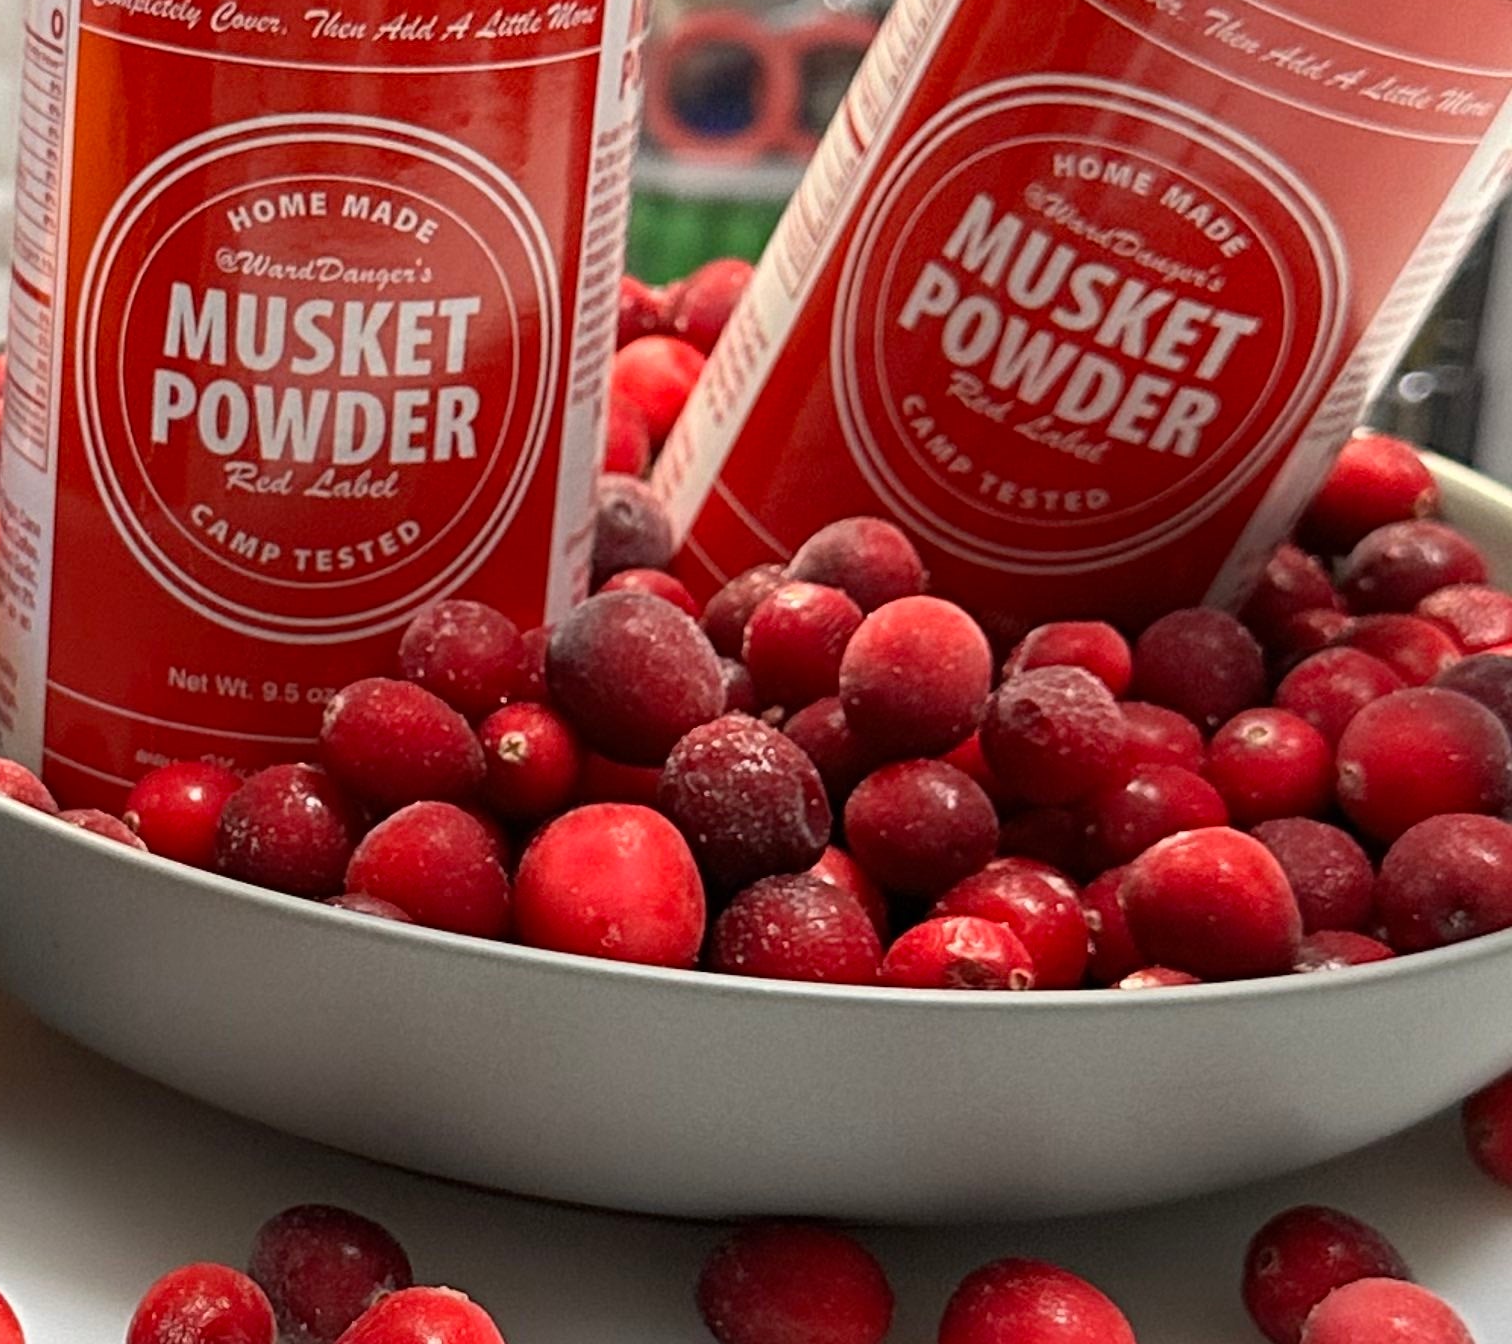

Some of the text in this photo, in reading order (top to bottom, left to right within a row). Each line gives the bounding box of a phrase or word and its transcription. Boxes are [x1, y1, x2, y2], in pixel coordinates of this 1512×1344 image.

[209, 0, 288, 36] Cover.
[303, 8, 366, 39] Then
[371, 11, 439, 41] Add
[439, 11, 474, 41] A
[475, 7, 541, 40] Little
[546, 1, 598, 31] More
[1203, 7, 1261, 54] Then
[1257, 45, 1335, 81] Add
[1322, 66, 1370, 91] A
[1358, 76, 1434, 111] Little
[1435, 86, 1496, 117] More
[226, 191, 439, 244] HOME MADE
[1052, 153, 1252, 259] HOME MADE
[214, 245, 433, 291] @WardDanger's
[940, 190, 1263, 381] MUSKET
[162, 281, 481, 377] MUSKET
[896, 259, 1222, 458] POWDER
[150, 367, 481, 466] POWDER
[901, 393, 1111, 513] CAMP TESTED
[944, 369, 1113, 464] Red Label
[223, 460, 400, 499] Red Label
[190, 503, 421, 572] CAMP TESTED
[167, 665, 209, 694] Net
[215, 674, 254, 701] Wt.
[261, 681, 300, 704] 9.5
